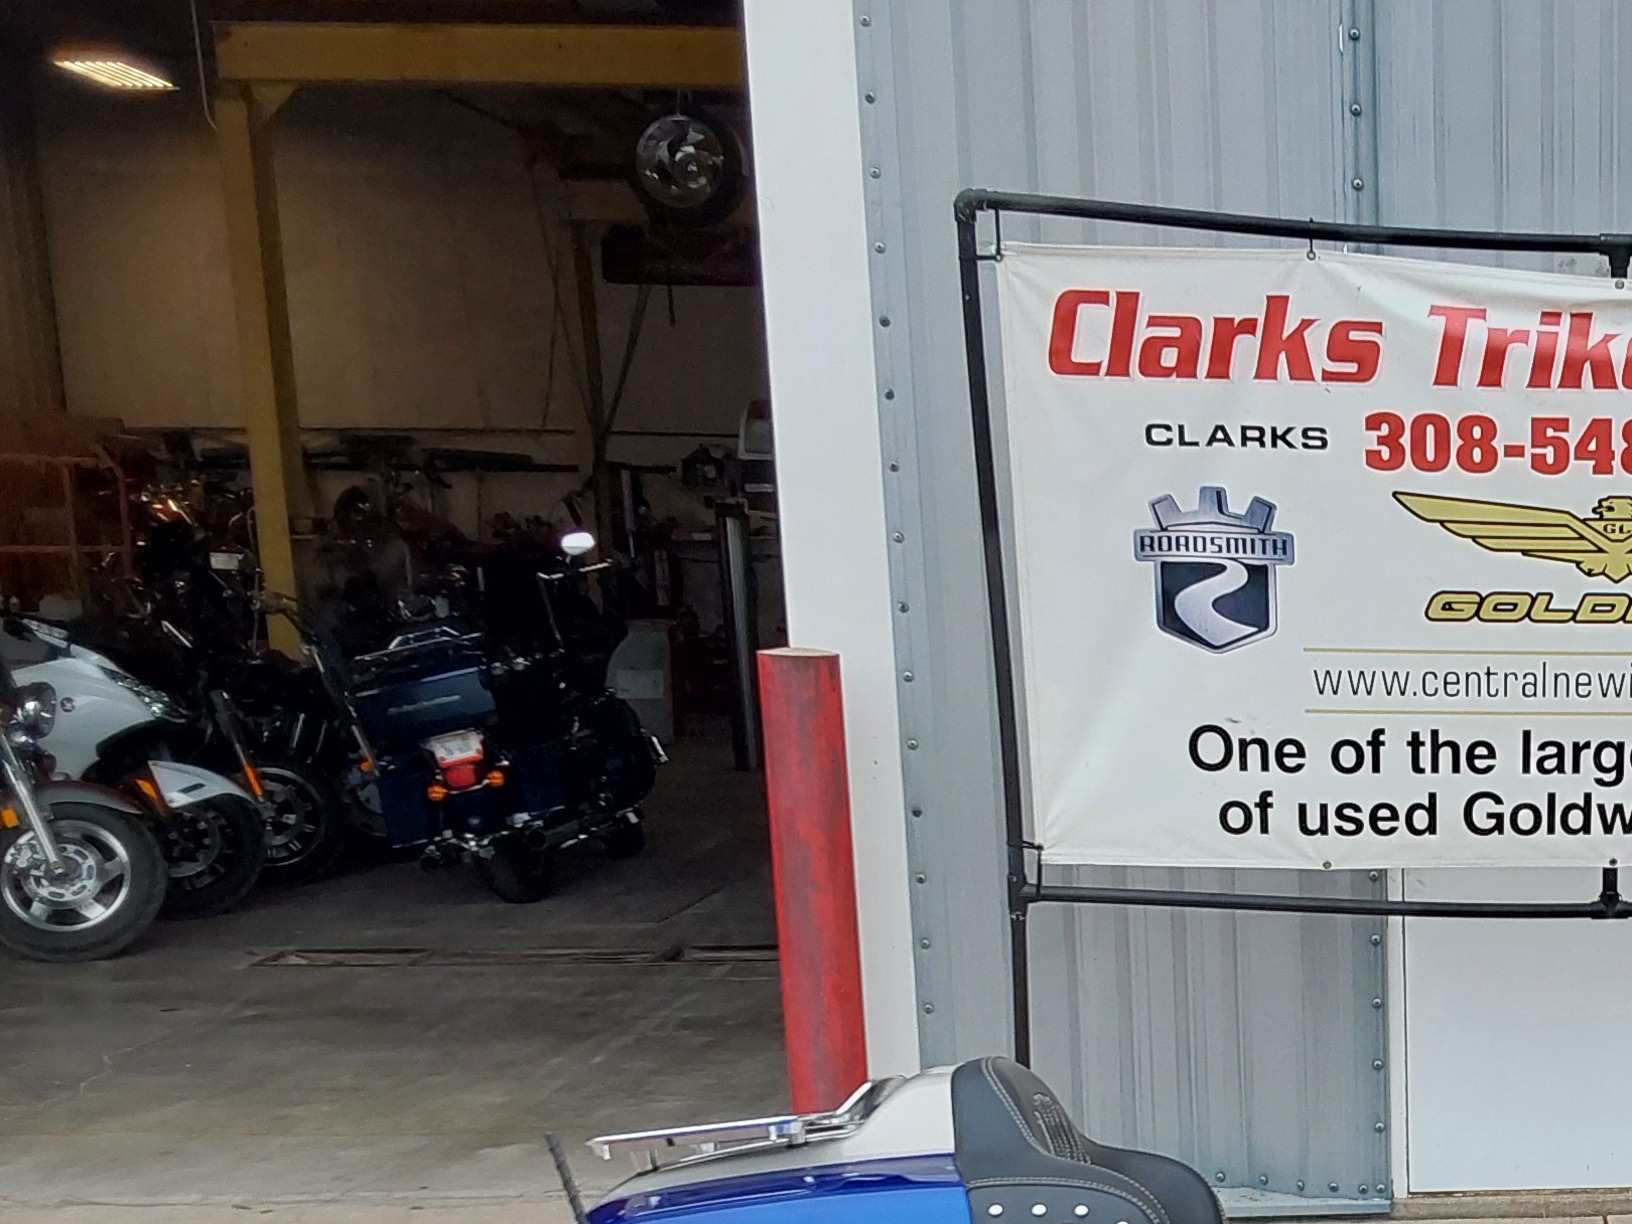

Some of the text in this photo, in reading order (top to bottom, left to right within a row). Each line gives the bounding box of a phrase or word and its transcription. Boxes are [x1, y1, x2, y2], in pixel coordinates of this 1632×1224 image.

[1048, 289, 1383, 383] Clarks
[1145, 423, 1328, 450] CLARKS
[1139, 535, 1288, 556] ROADSMITH
[1603, 523, 1632, 535] GL
[1188, 724, 1307, 774] One
[1330, 728, 1386, 775] of
[1406, 729, 1497, 775] the
[1219, 790, 1274, 836] of
[1298, 791, 1437, 837] used
